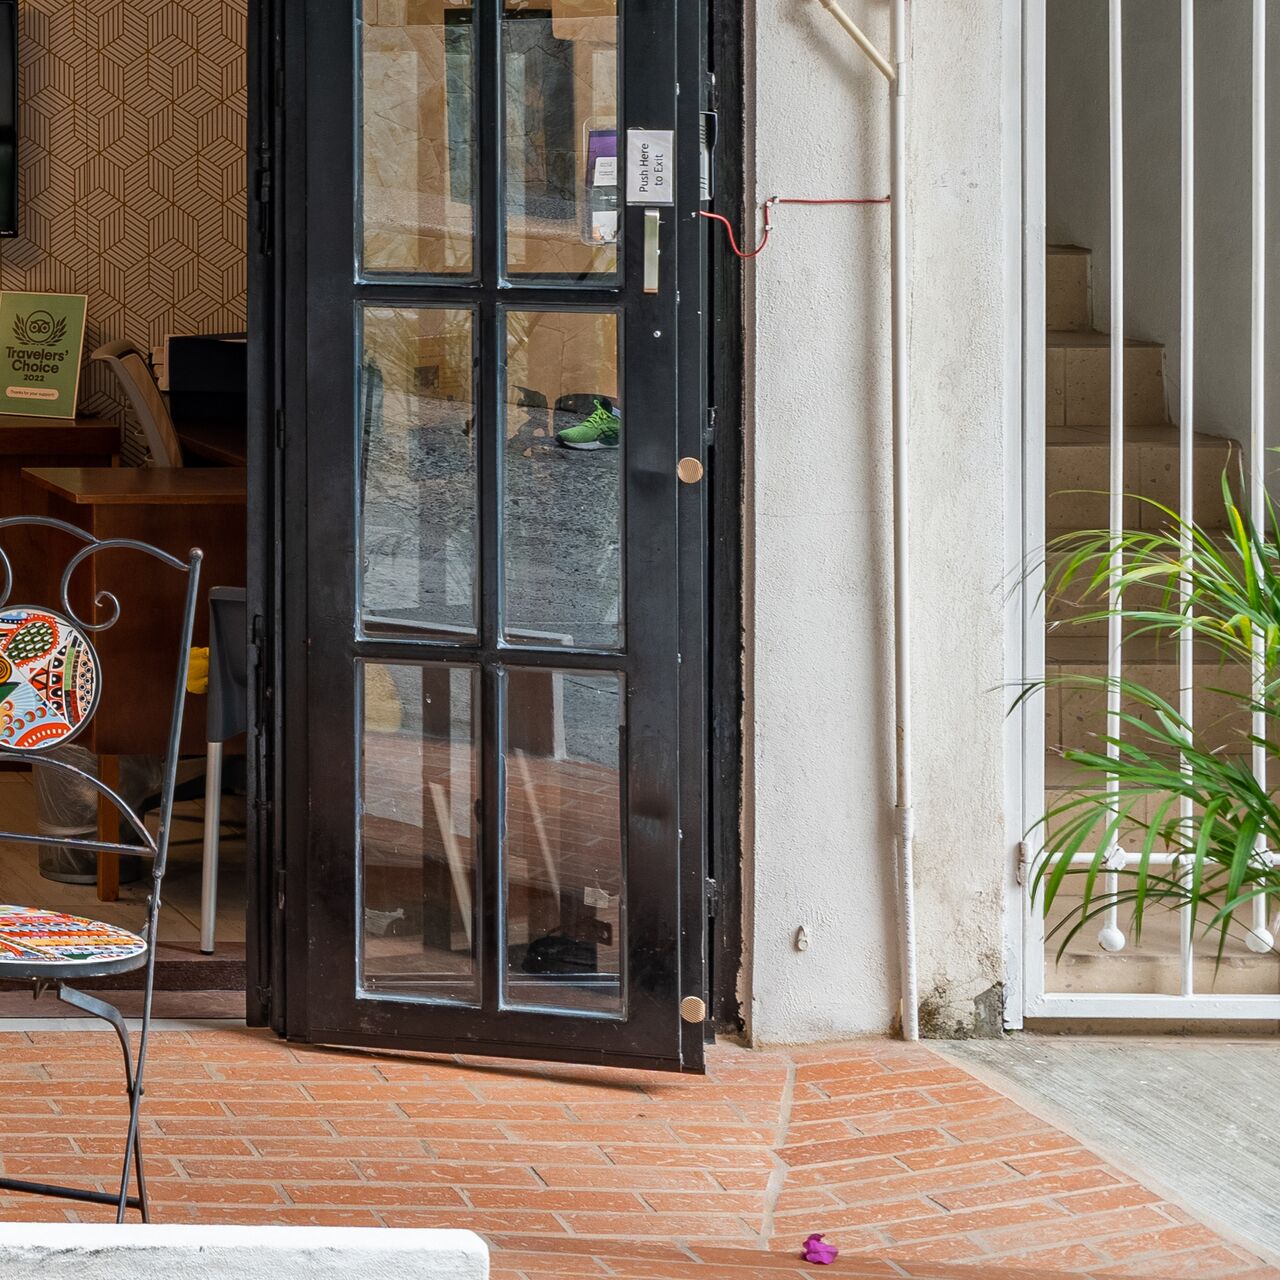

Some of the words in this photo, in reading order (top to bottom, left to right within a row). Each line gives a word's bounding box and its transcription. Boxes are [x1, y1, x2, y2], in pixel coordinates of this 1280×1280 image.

[639, 143, 649, 167] Here
[653, 153, 664, 173] Exit
[638, 170, 649, 193] Push
[654, 175, 664, 186] to
[5, 346, 69, 362] Travelers'
[11, 359, 60, 374] Choice
[23, 374, 45, 382] 2022
